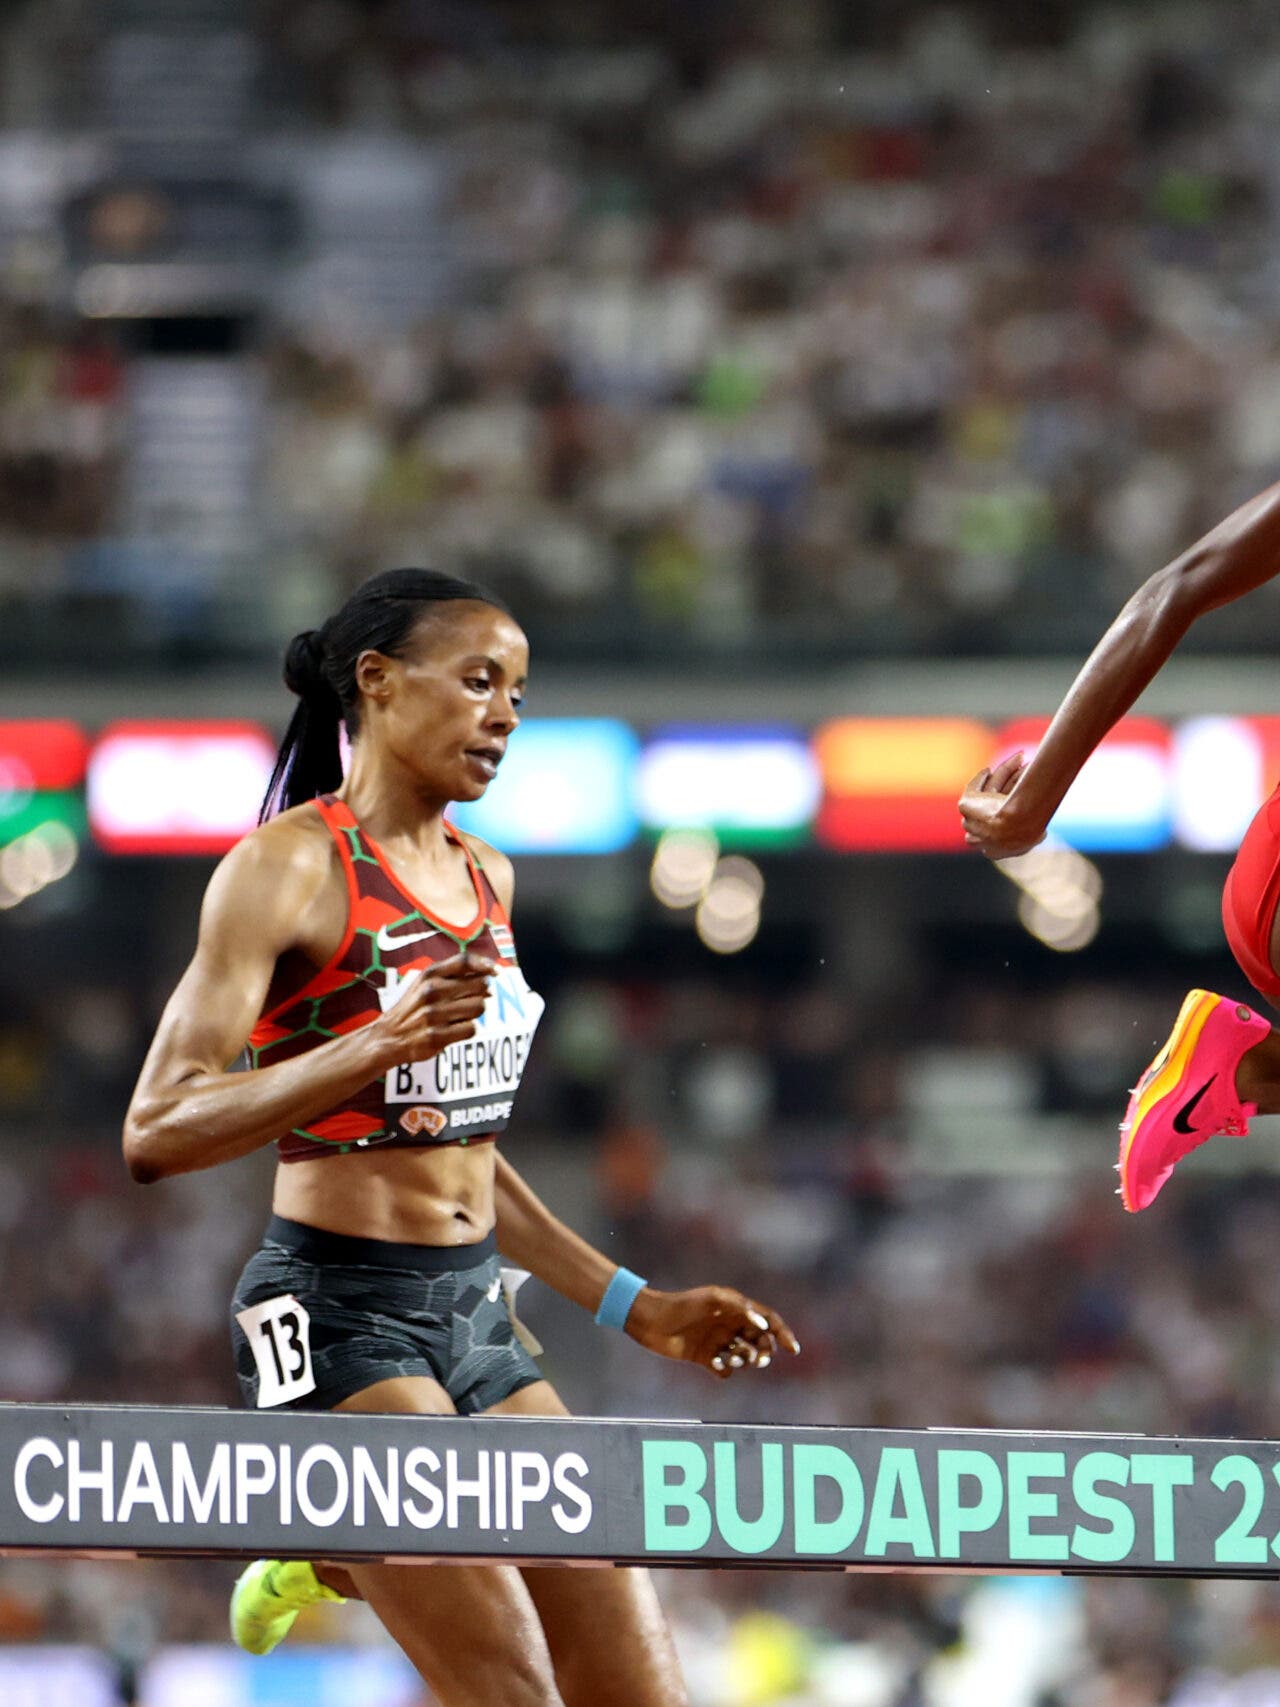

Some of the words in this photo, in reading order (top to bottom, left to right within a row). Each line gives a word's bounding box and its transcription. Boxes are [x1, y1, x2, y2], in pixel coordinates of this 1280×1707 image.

[396, 1061, 423, 1096] B.
[435, 1032, 530, 1094] CHEPKOE
[260, 1312, 305, 1386] 13
[14, 1436, 593, 1534] CHAMPIONSHIPS
[642, 1440, 1194, 1562] BUDAPEST
